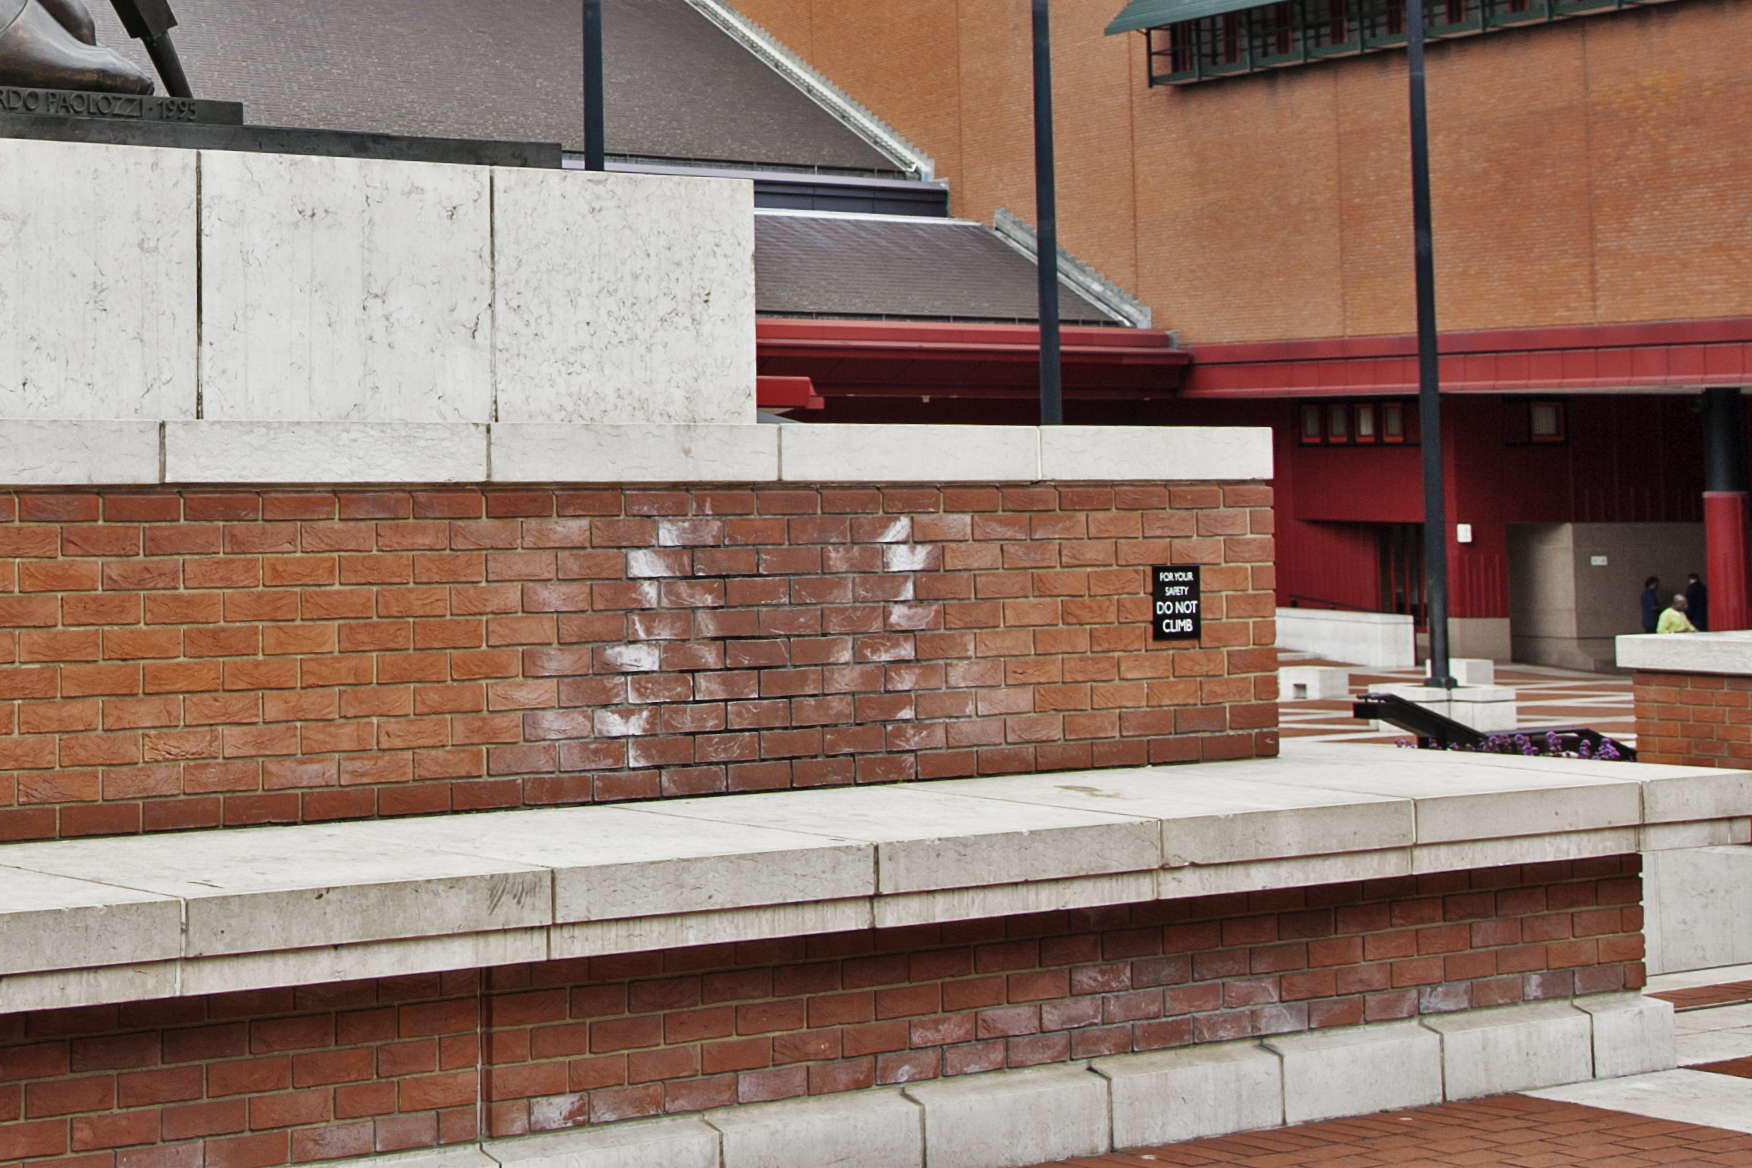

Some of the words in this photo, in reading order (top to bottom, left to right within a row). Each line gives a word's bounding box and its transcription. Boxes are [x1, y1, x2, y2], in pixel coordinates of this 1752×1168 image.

[46, 92, 144, 118] PAOLOZZI
[157, 99, 197, 122] 1995
[1159, 572, 1174, 581] FOR
[1174, 572, 1193, 581] YOUR
[1165, 586, 1189, 596] SAFETY
[1156, 601, 1173, 615] DO
[1175, 600, 1198, 614] NOT
[1162, 619, 1193, 633] CLIMB
